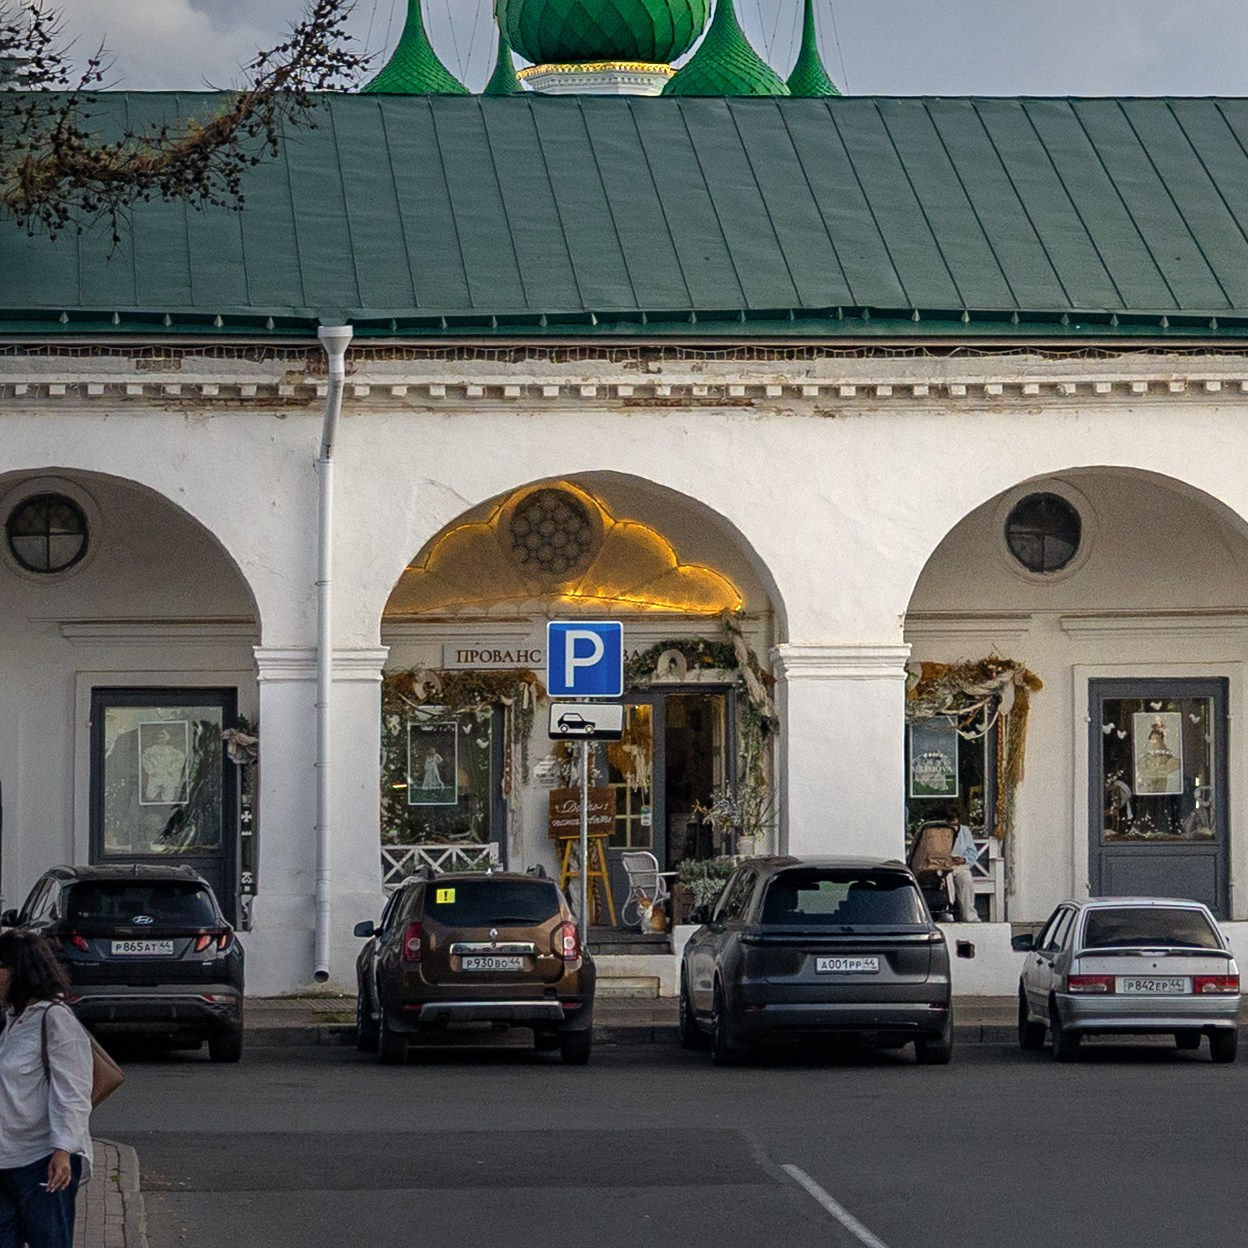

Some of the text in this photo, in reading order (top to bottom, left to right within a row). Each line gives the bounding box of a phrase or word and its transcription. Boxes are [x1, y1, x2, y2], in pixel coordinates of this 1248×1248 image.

[456, 649, 542, 664] ПРОВАНС
[564, 629, 605, 688] P
[821, 959, 862, 970] А001РР
